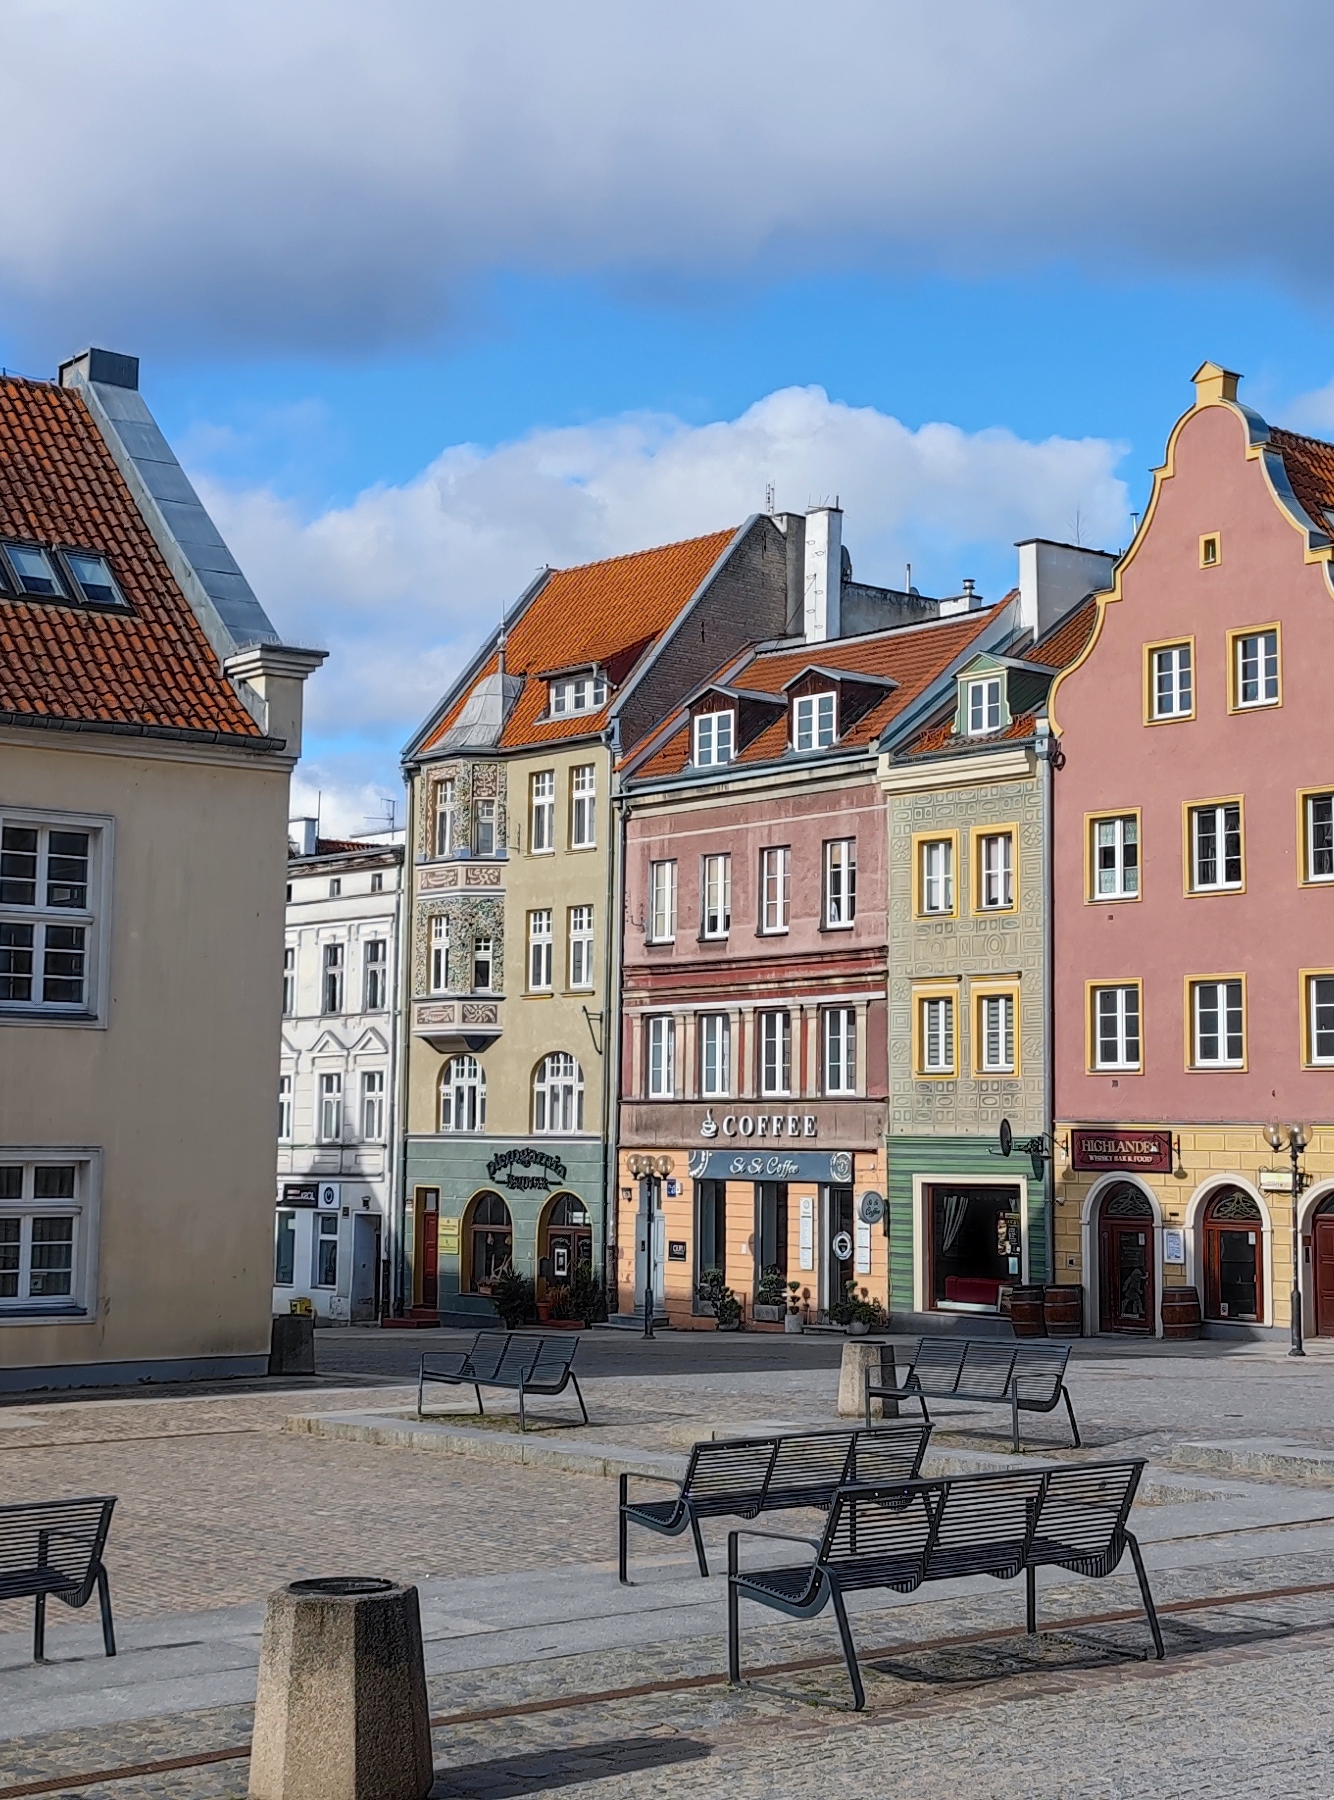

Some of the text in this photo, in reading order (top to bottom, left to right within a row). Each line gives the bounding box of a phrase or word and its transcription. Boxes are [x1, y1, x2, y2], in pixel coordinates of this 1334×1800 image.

[722, 1115, 817, 1137] COFFEE
[766, 1157, 800, 1178] Coffee
[1134, 1155, 1153, 1163] FOOD
